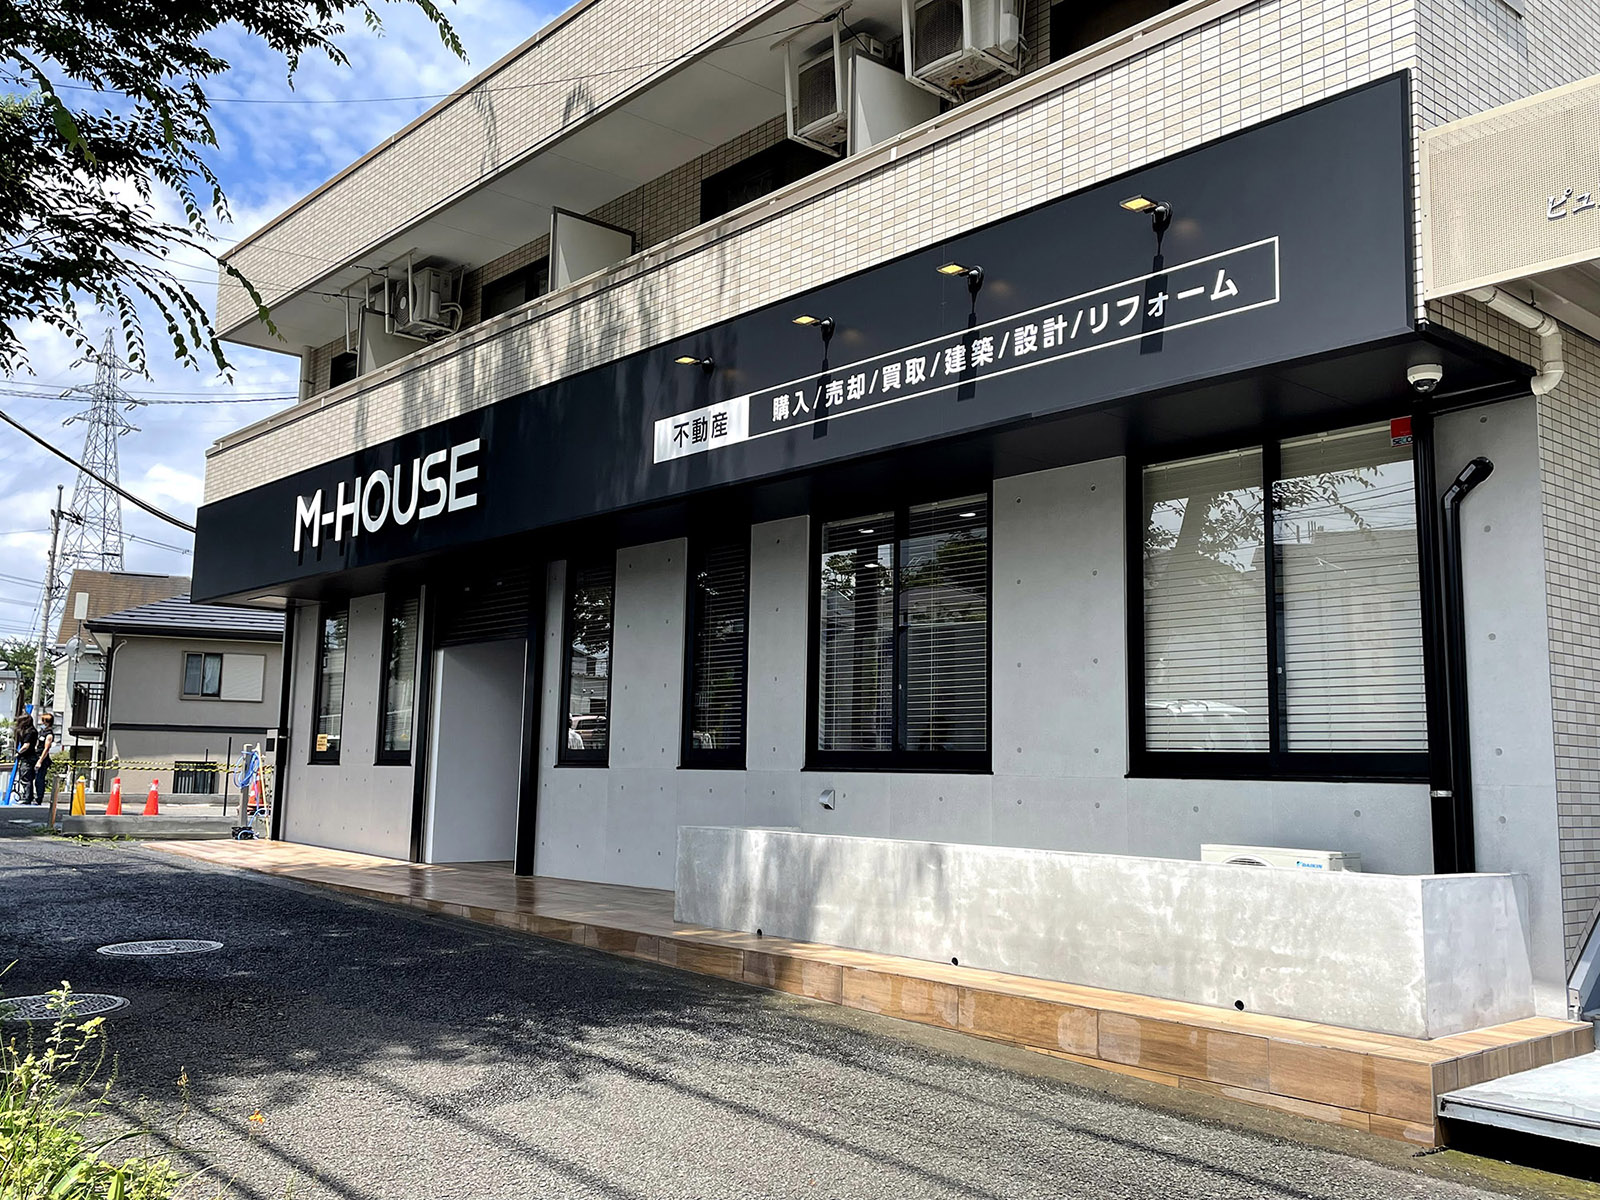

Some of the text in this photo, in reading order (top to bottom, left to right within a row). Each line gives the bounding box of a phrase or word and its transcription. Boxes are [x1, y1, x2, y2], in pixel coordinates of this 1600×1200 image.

[1547, 187, 1600, 220] ピュ
[673, 411, 728, 448] 不動産
[293, 438, 481, 552] M-HOUSE
